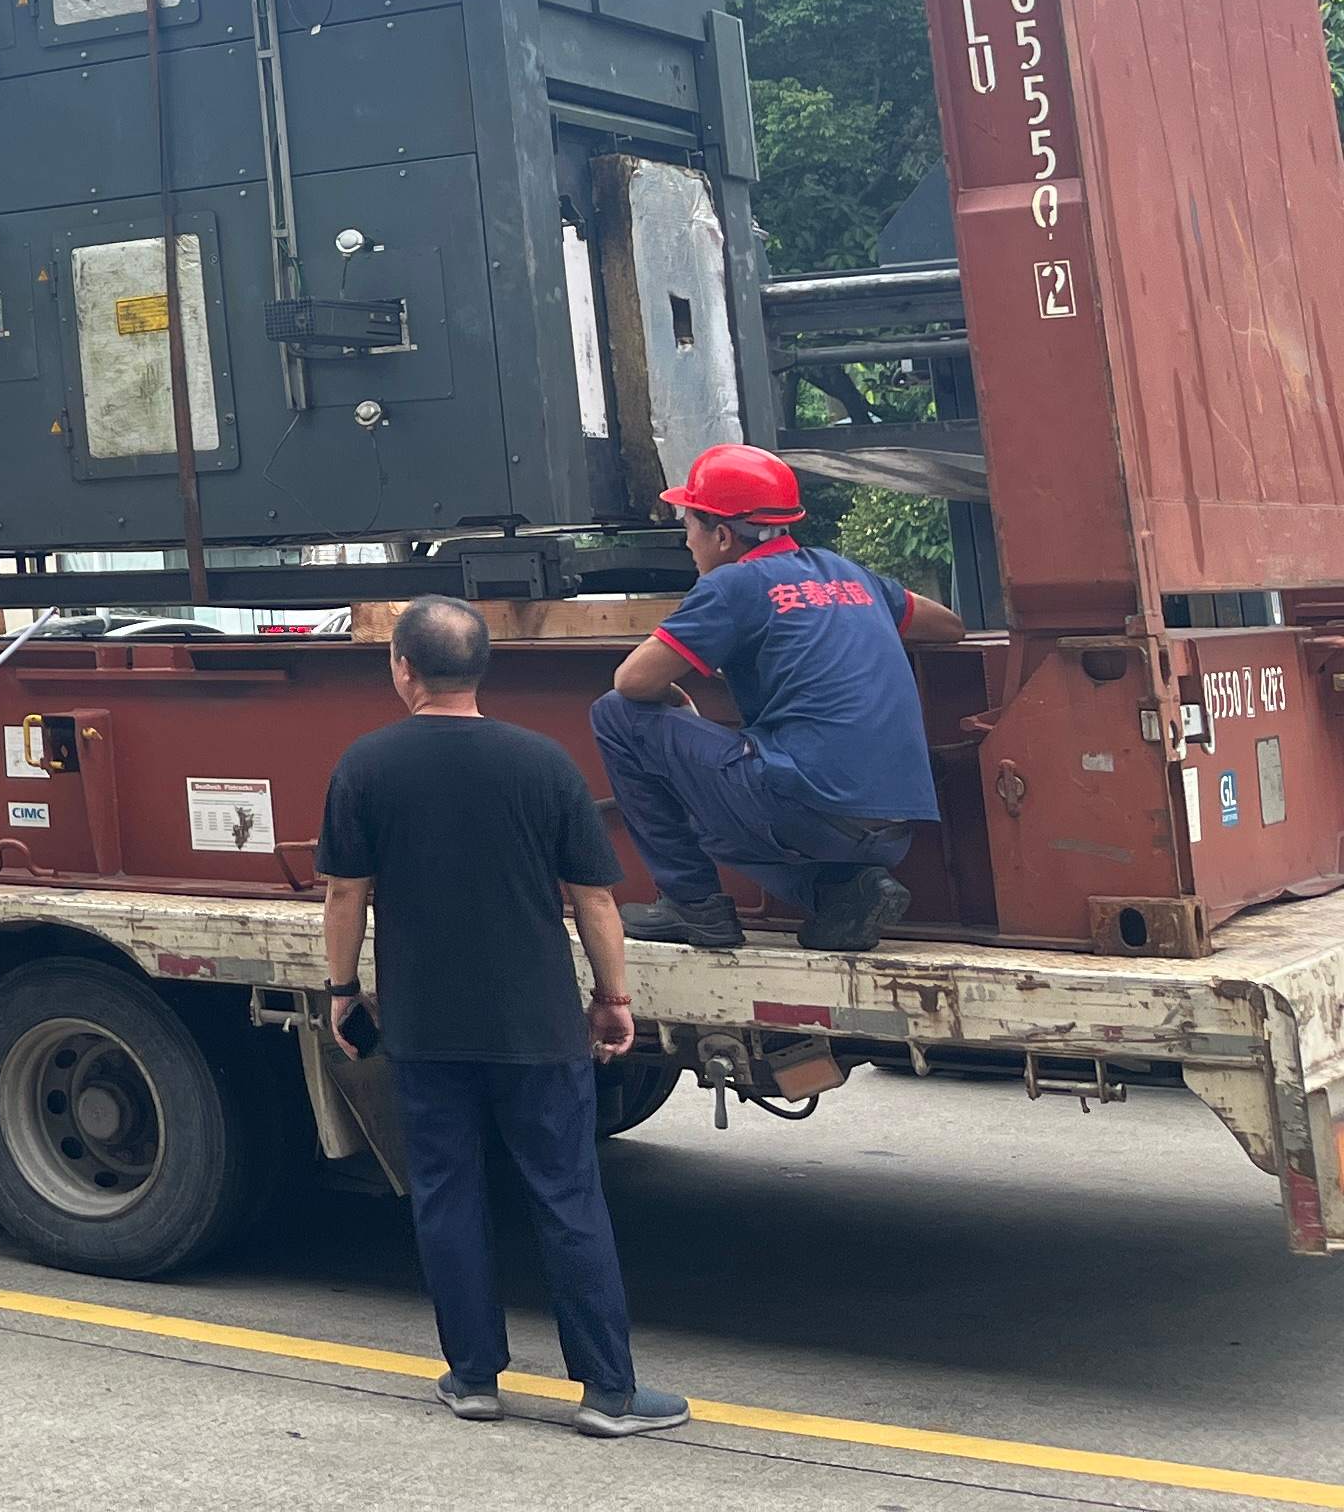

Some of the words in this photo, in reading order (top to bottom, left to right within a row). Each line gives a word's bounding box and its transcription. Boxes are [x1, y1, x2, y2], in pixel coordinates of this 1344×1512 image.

[1039, 263, 1072, 317] 2
[1204, 670, 1242, 719] 05550
[1220, 775, 1237, 807] GL
[12, 807, 46, 819] CIMC
